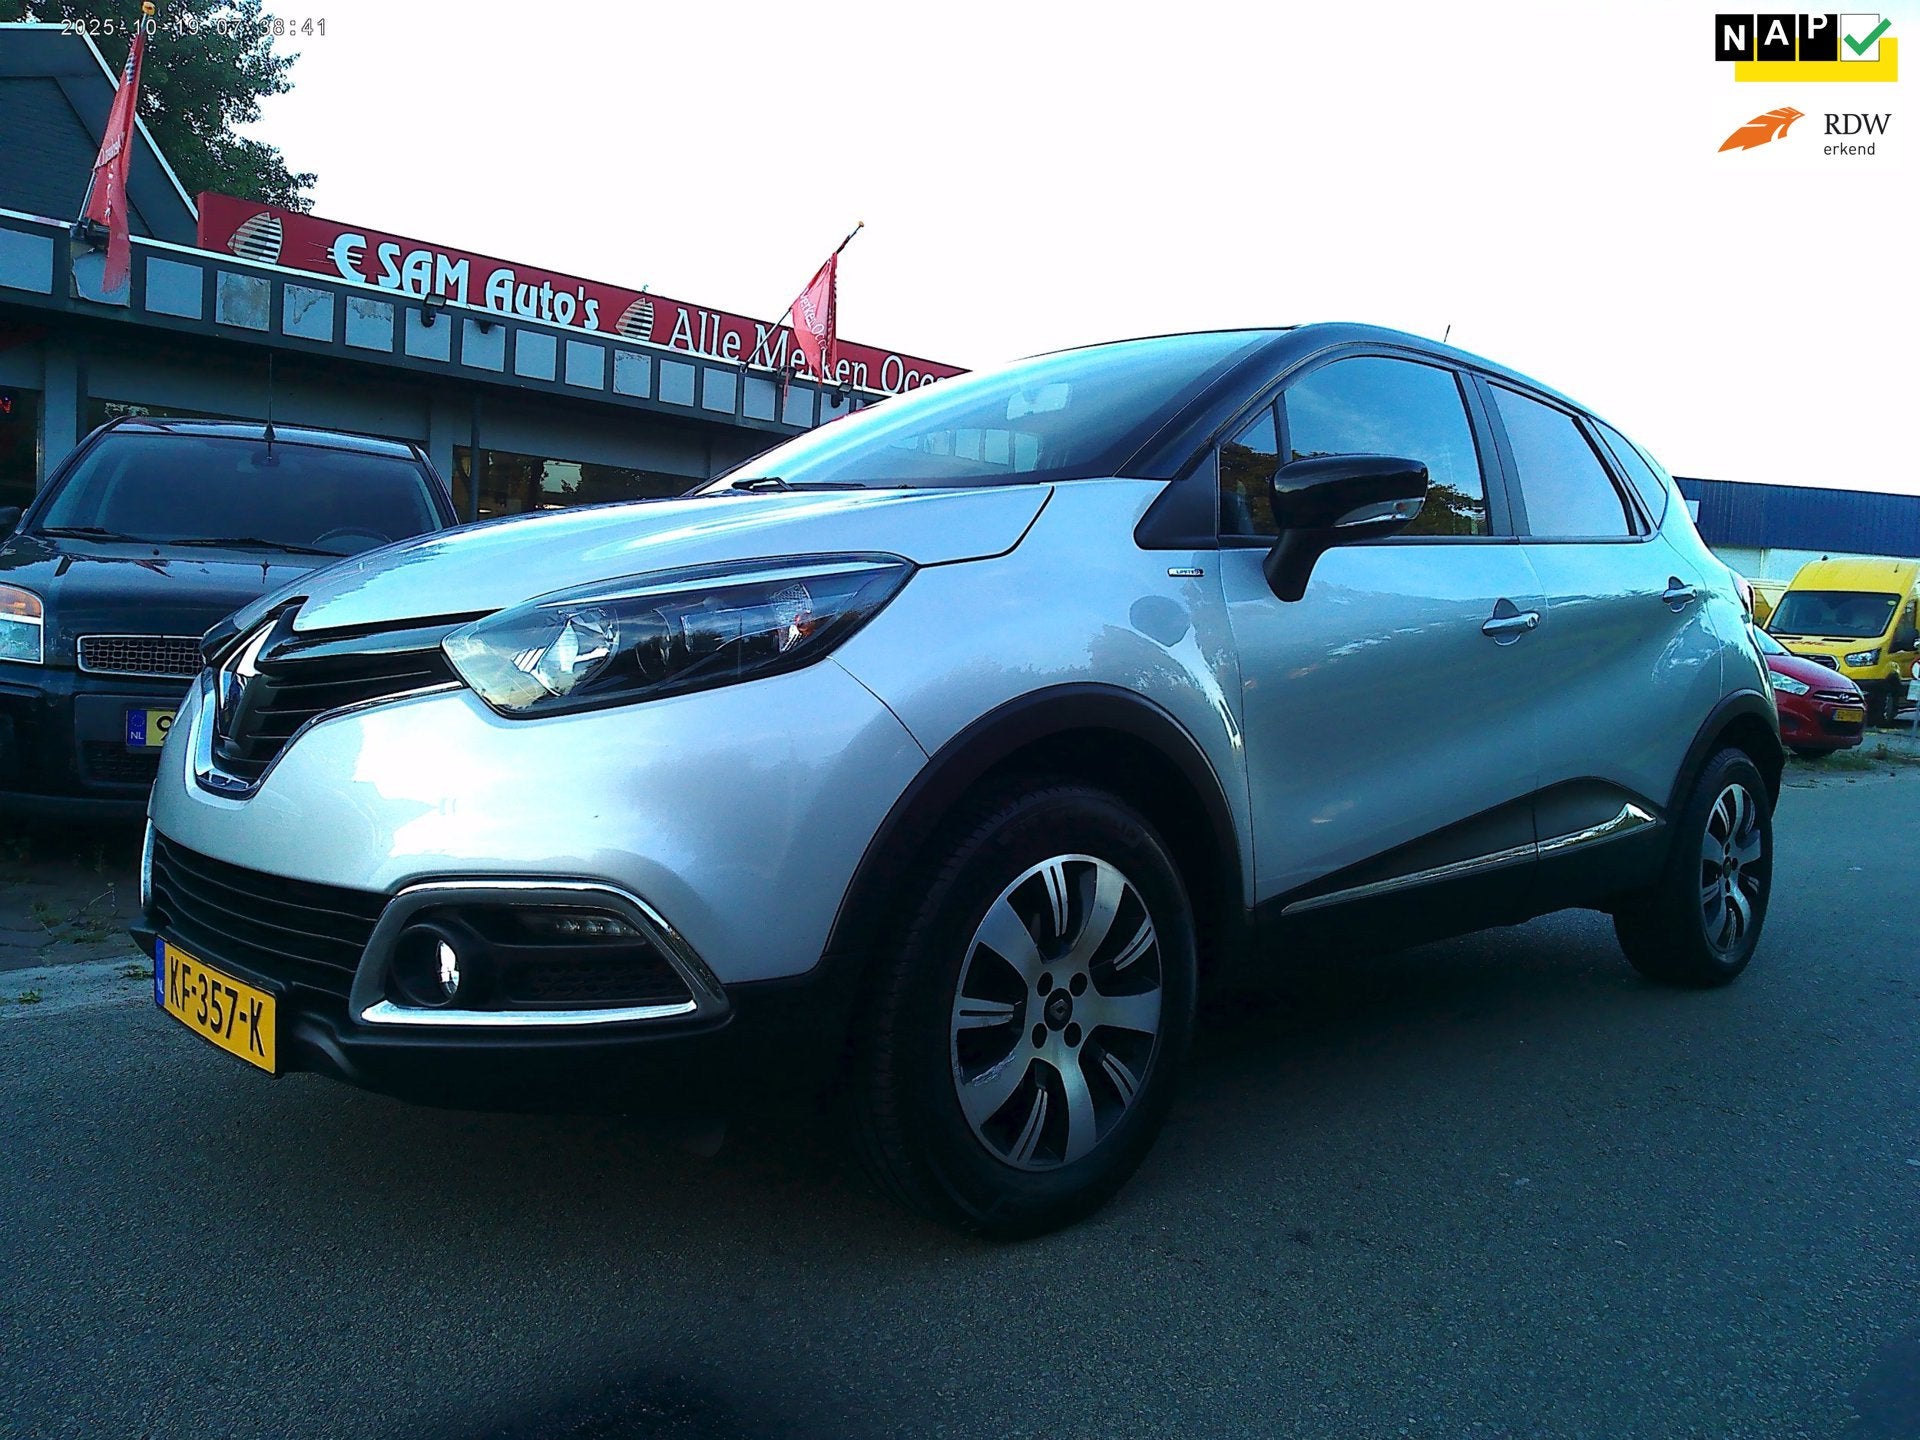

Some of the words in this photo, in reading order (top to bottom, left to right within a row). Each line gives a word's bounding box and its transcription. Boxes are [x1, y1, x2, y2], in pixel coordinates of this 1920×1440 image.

[486, 269, 599, 330] Auto's
[668, 308, 741, 362] Alle
[881, 354, 946, 393] Occ
[131, 731, 144, 740] NL
[170, 955, 265, 1057] KF-357-K
